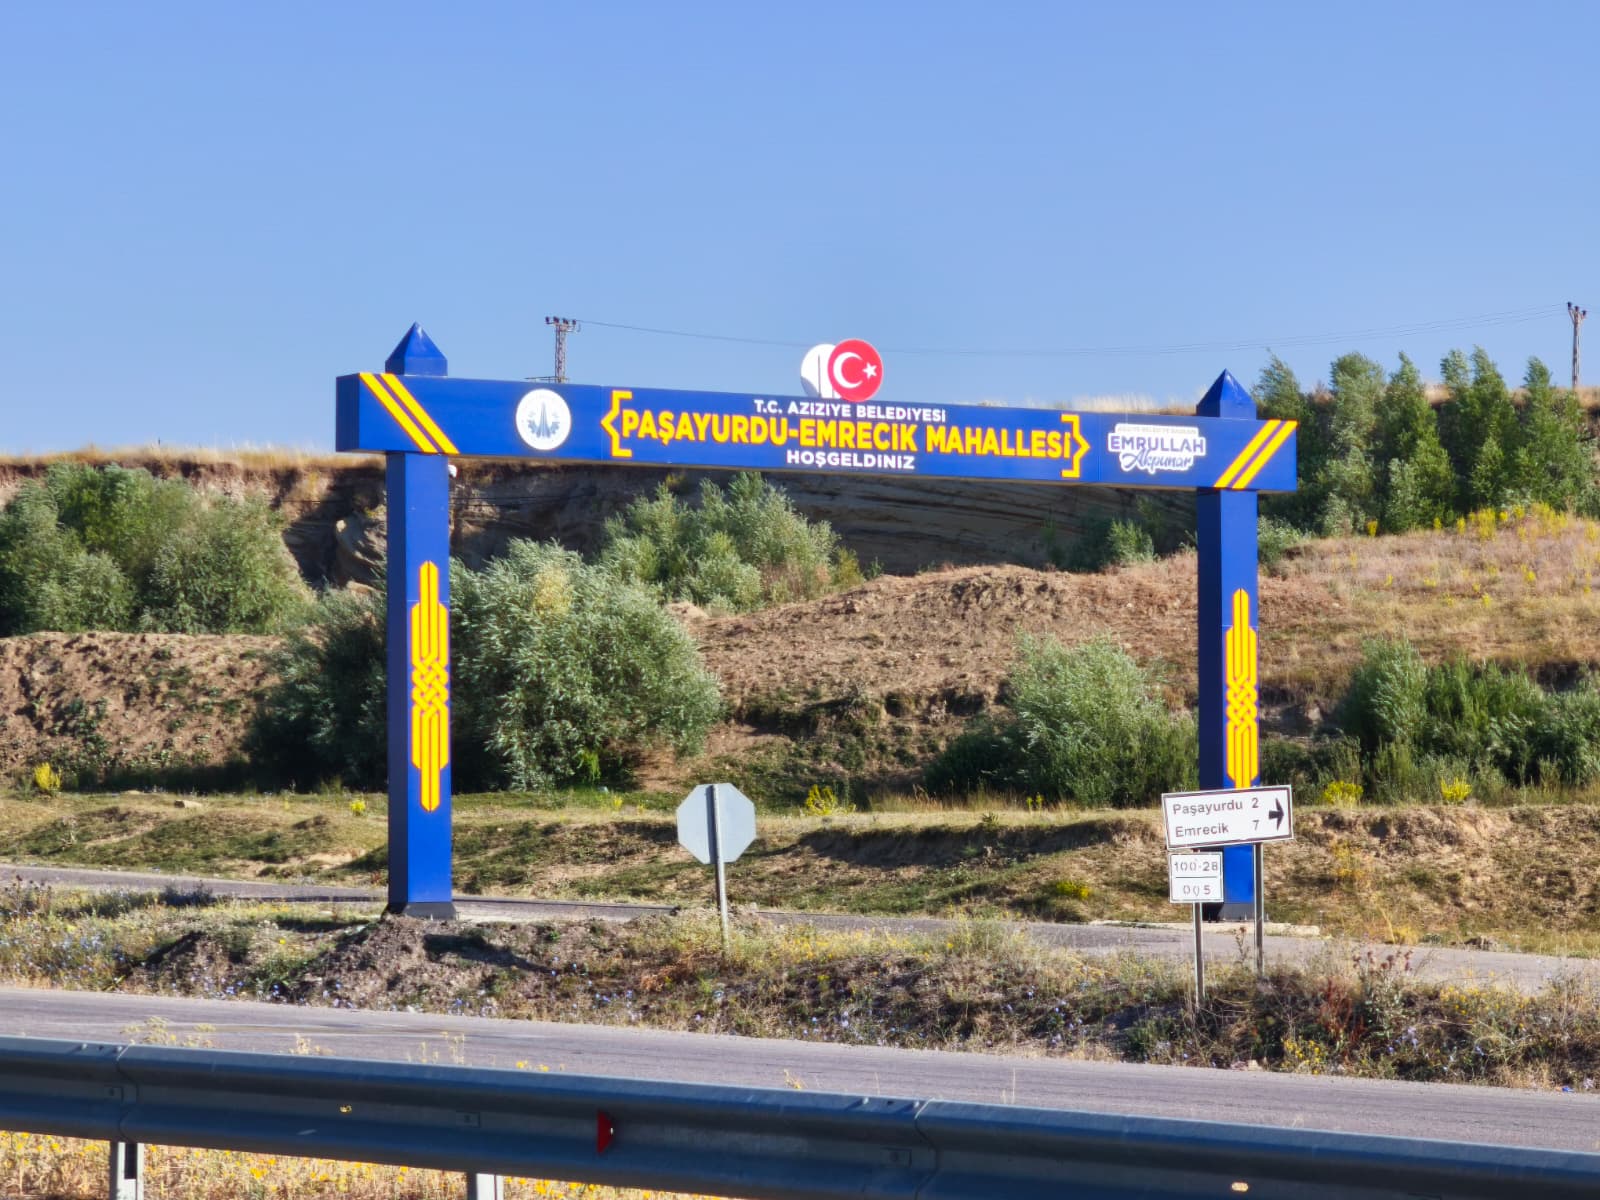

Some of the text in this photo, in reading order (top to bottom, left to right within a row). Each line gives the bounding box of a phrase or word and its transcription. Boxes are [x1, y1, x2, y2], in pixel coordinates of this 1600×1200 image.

[754, 400, 783, 413] T.C.
[926, 425, 1071, 458] MAHALLESİ
[1110, 435, 1204, 453] EMRULLAH
[1173, 797, 1260, 816] Paşayurdu 2
[1175, 819, 1260, 838] Emrecik 7
